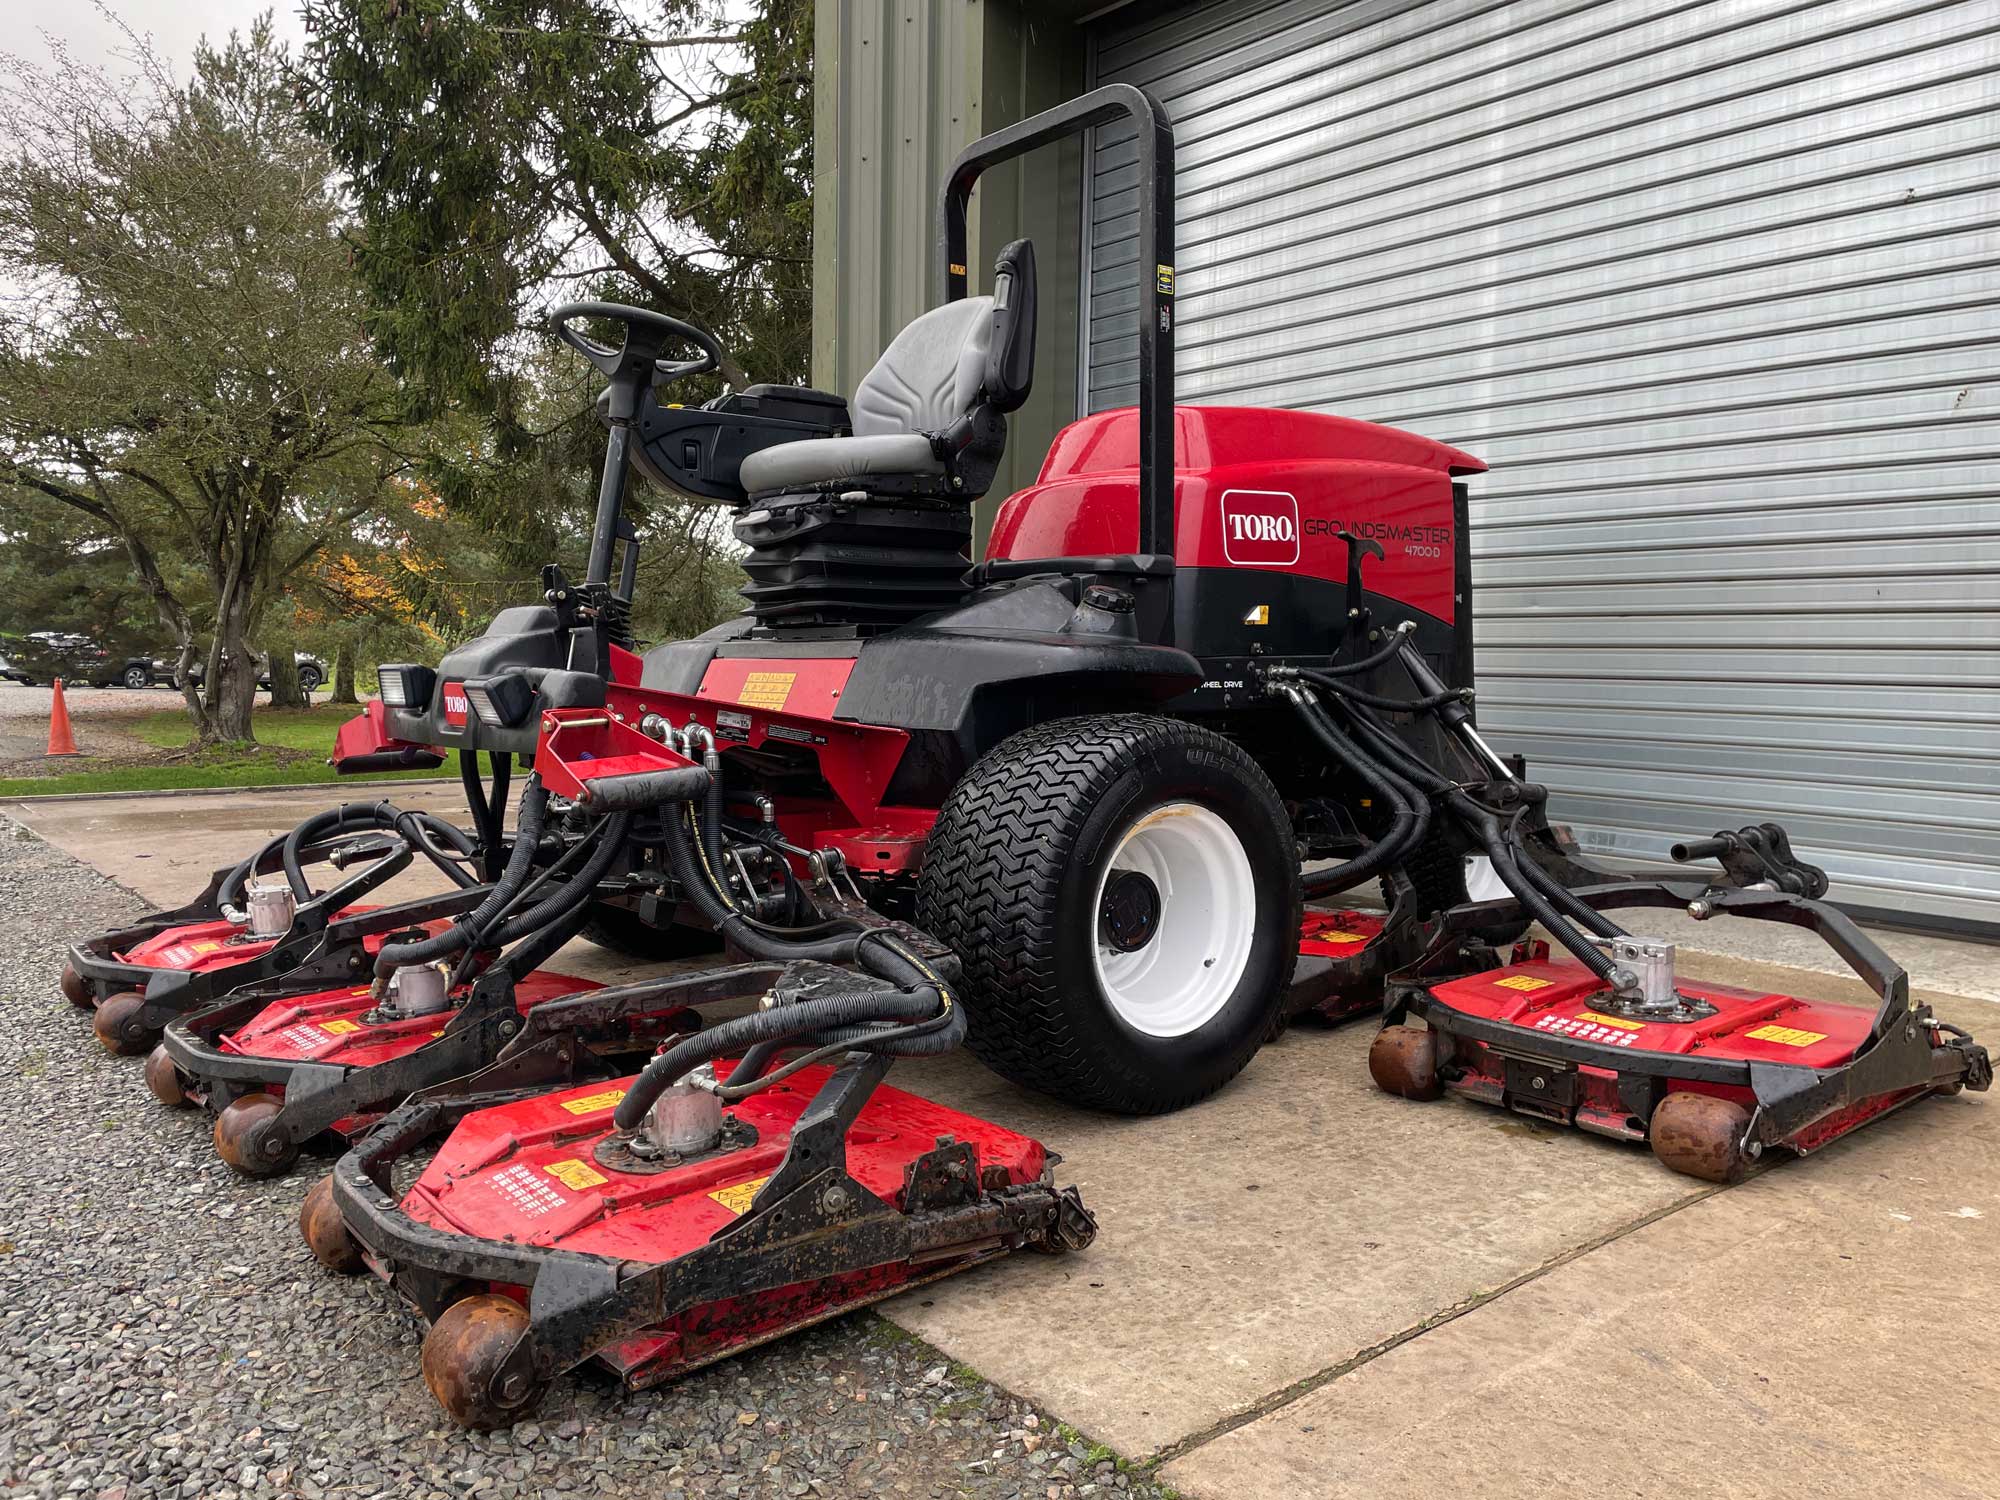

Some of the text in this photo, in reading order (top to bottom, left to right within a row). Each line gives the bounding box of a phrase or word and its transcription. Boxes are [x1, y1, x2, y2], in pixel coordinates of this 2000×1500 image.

[1229, 514, 1293, 541] TORO
[1304, 519, 1450, 544] GROUNDSMASTER
[445, 696, 468, 713] TORO
